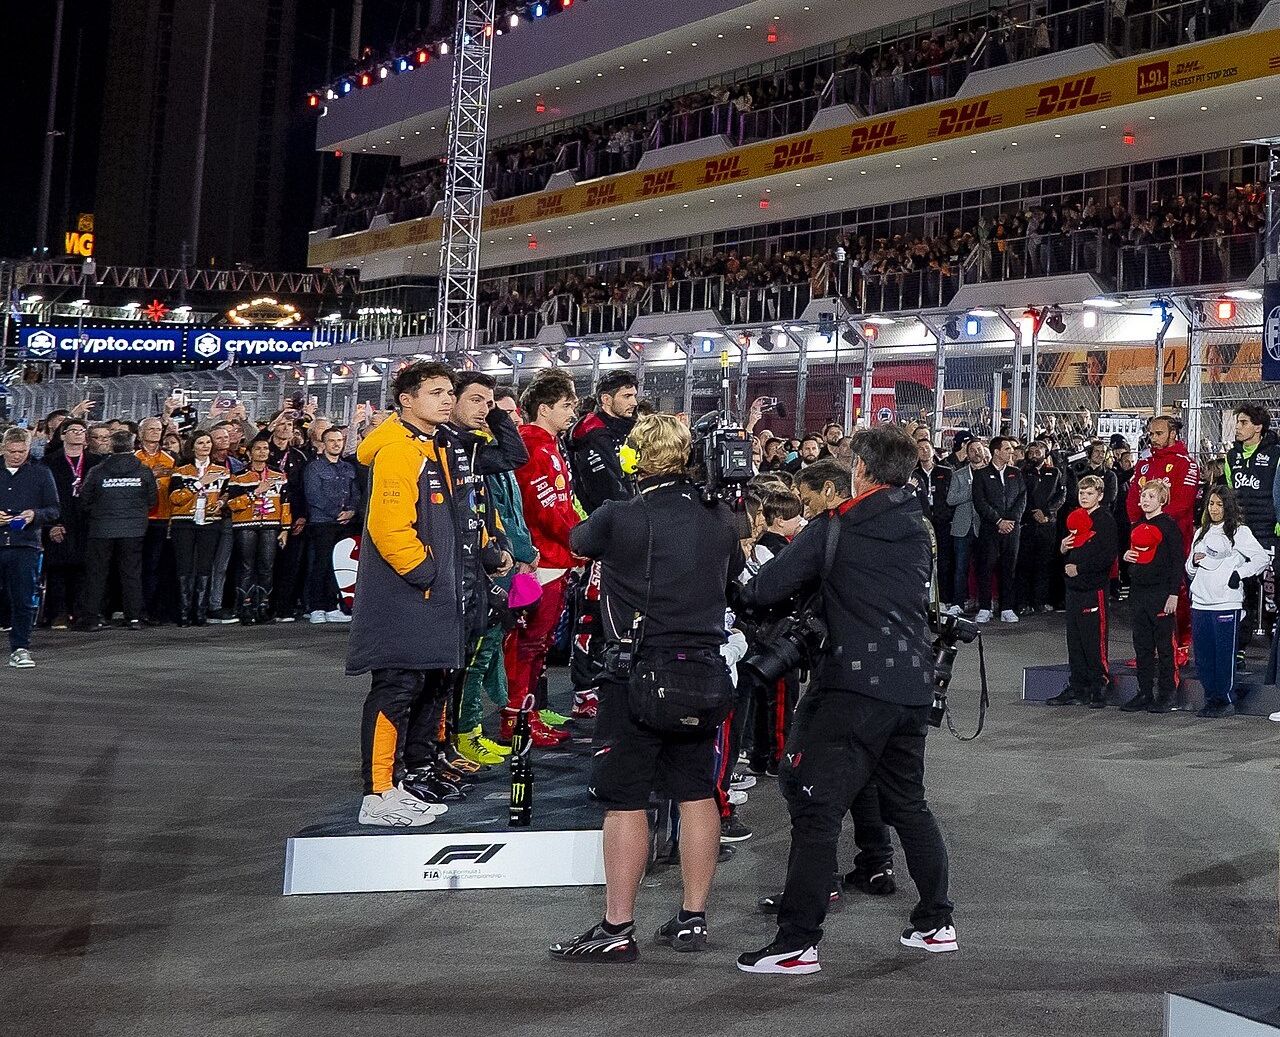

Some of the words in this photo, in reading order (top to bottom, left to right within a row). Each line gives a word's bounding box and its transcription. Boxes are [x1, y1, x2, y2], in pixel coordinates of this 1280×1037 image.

[1206, 70, 1222, 82] STOP
[1036, 76, 1101, 116] DHL
[938, 99, 993, 136] DHL
[850, 120, 900, 153] DHL
[773, 139, 816, 169] DHL
[642, 170, 676, 196] DHL
[704, 156, 742, 184] DHL
[586, 182, 617, 207] DHL
[60, 337, 175, 354] crypto.com
